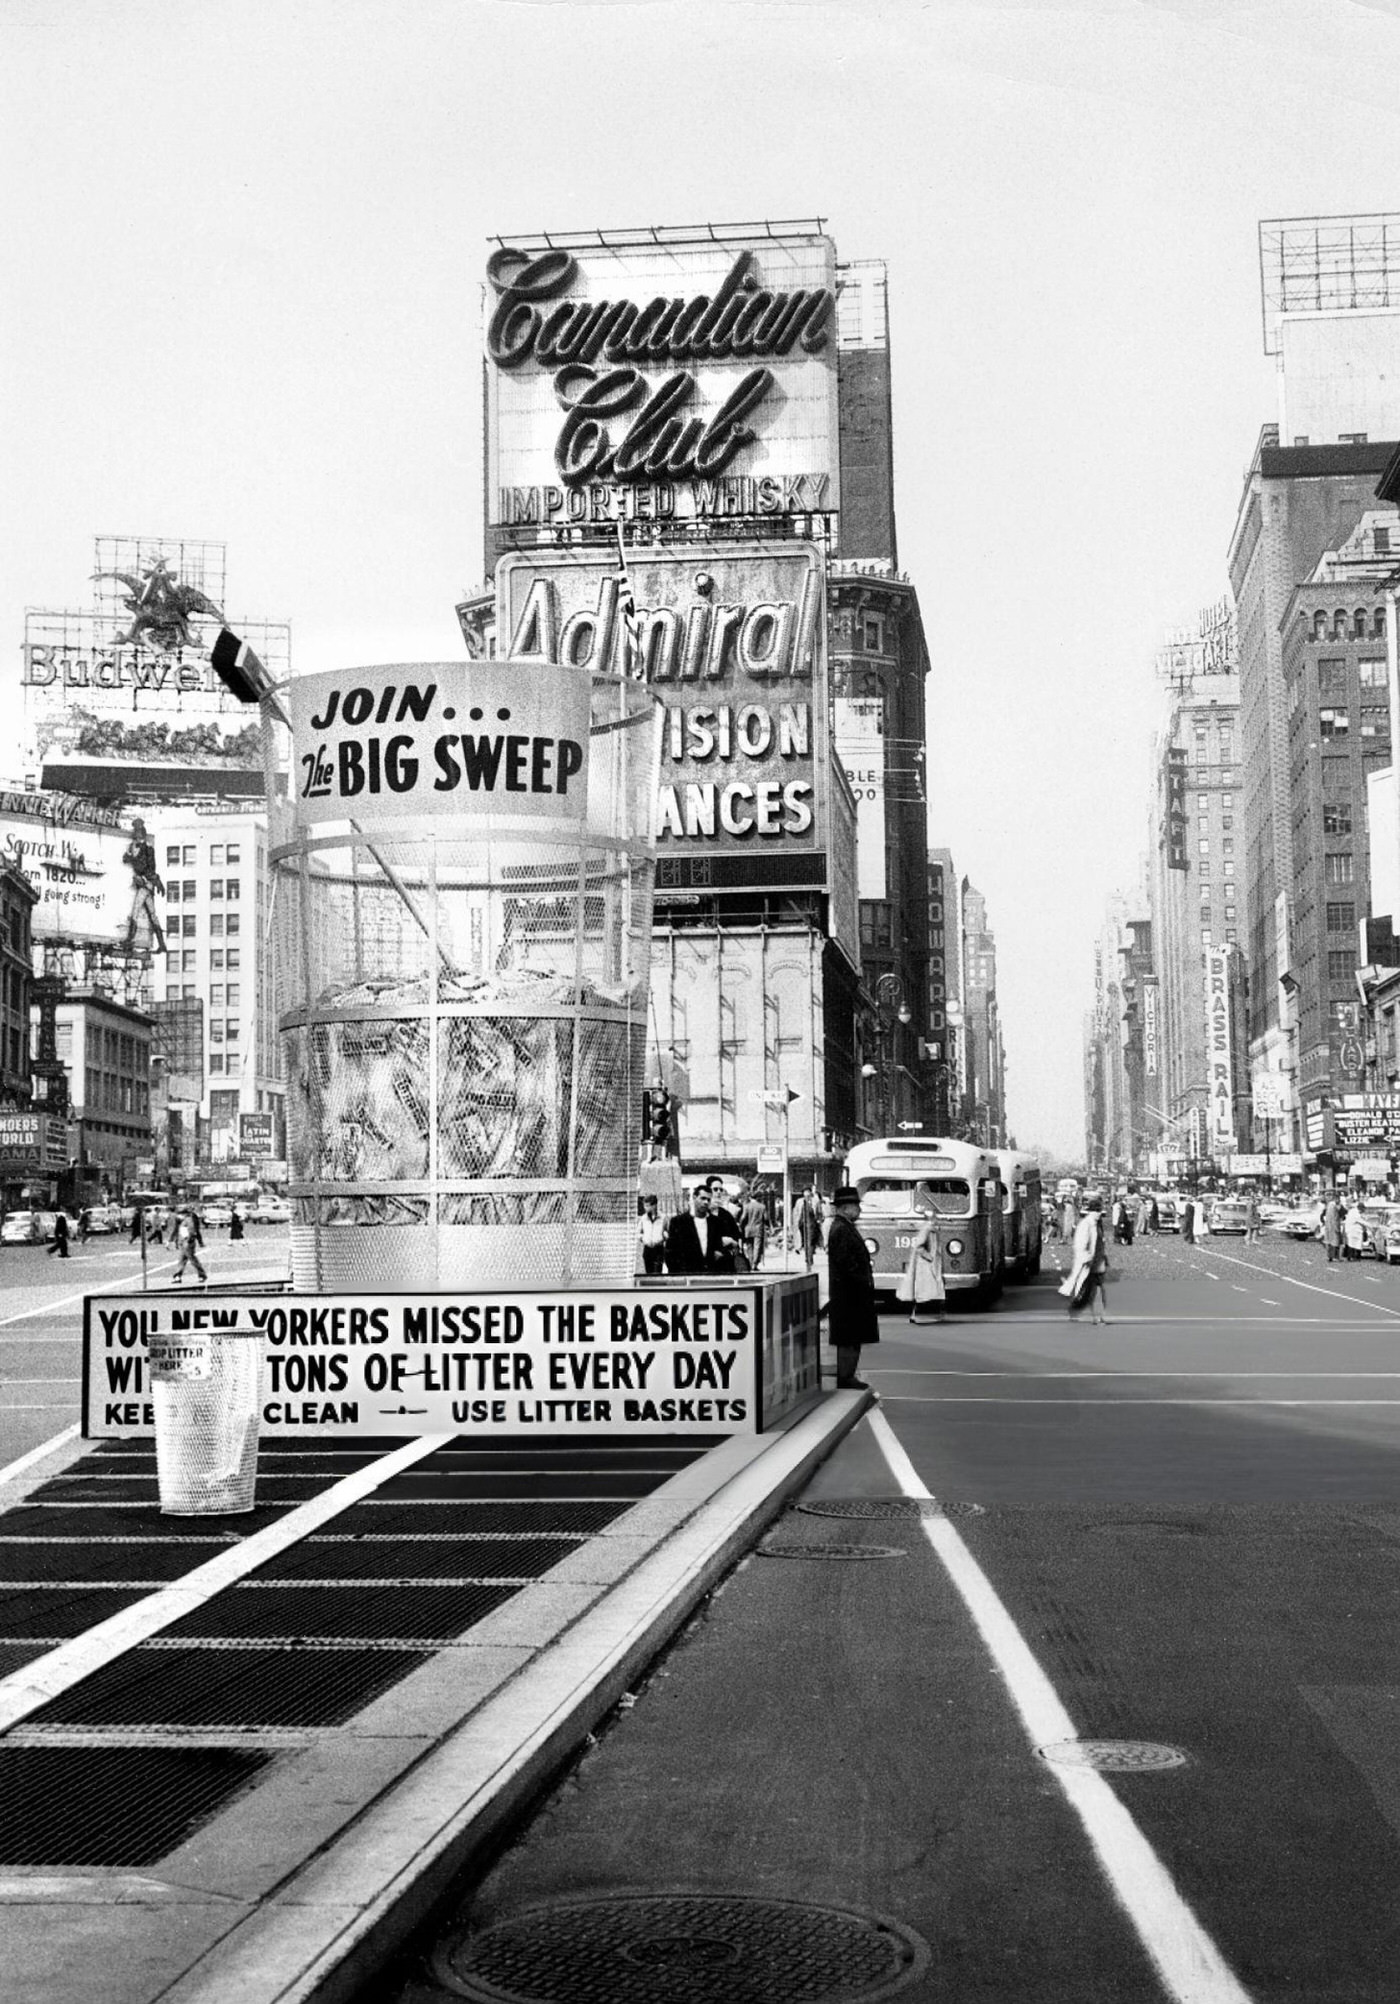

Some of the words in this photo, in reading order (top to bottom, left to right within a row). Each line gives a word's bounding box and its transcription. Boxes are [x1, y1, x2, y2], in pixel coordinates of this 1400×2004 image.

[486, 247, 834, 367] Canadian
[553, 363, 774, 485] Club
[501, 481, 675, 523] IMPORTED
[695, 473, 830, 516] WHISKY
[508, 568, 820, 681] Admiral
[21, 643, 222, 692] Budwei
[301, 744, 334, 798] The
[338, 735, 419, 797] BIG
[433, 734, 583, 795] SWEEP
[927, 875, 945, 1031] HOWARD
[1145, 988, 1155, 1074] VICTORIA
[1211, 958, 1227, 1051] BRASS
[1214, 1064, 1229, 1136] RAIL
[403, 1305, 524, 1343] MISSED
[537, 1306, 595, 1342] THE
[611, 1303, 748, 1342] BASKETS
[266, 1354, 348, 1392] TONS
[364, 1354, 408, 1392] OF
[424, 1352, 533, 1391] LITTER
[549, 1351, 655, 1390] EVERY
[673, 1350, 736, 1390] DAY
[263, 1402, 358, 1424] CLEAN
[452, 1400, 507, 1423] USE
[518, 1400, 612, 1422] LITTER
[624, 1399, 747, 1422] BASKETS
